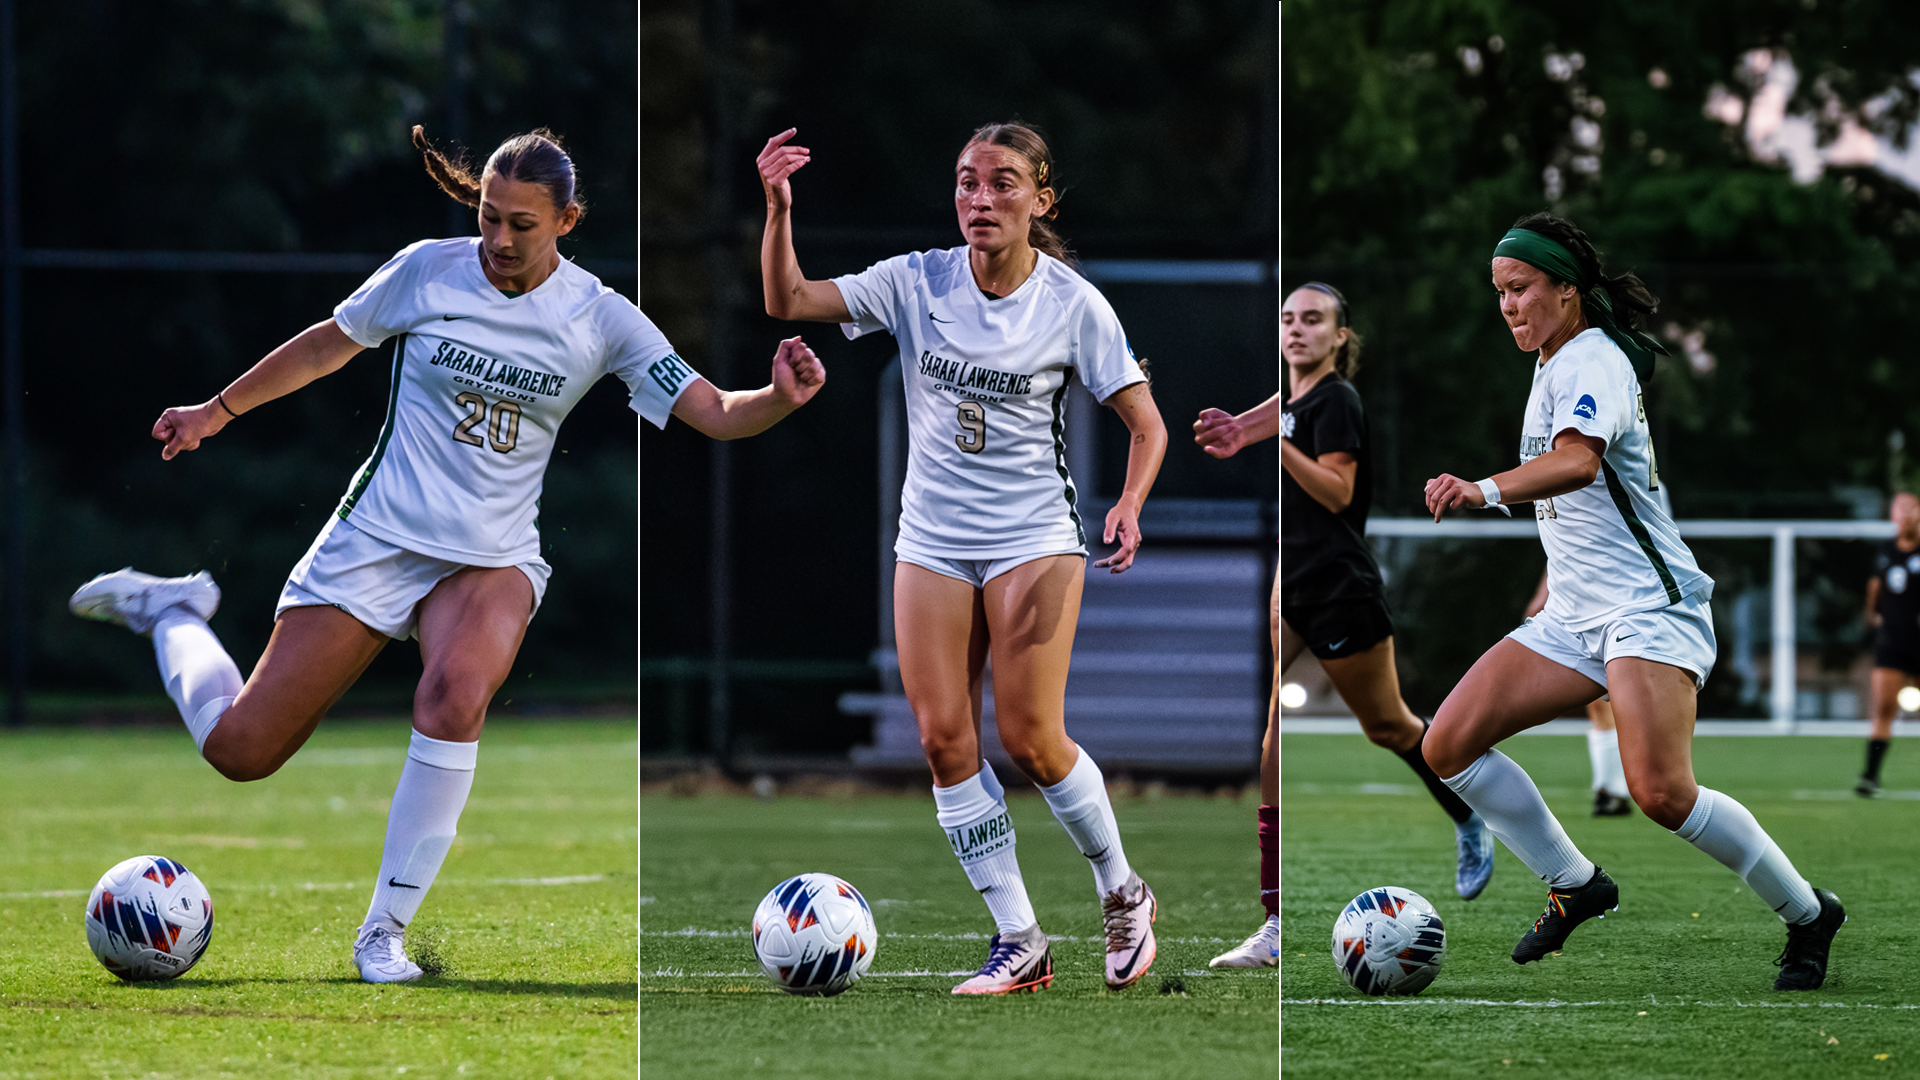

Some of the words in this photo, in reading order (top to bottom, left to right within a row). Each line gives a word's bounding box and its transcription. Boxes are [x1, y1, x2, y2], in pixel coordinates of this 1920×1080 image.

[430, 341, 483, 376] SARAH
[483, 358, 567, 397] LAWRENCE
[453, 375, 537, 403] GRYPHONS
[920, 350, 959, 383] SARAH
[956, 361, 1033, 395] LAWRENCE
[452, 391, 522, 454] 20
[955, 400, 986, 455] 9
[957, 812, 1013, 854] LAWREN
